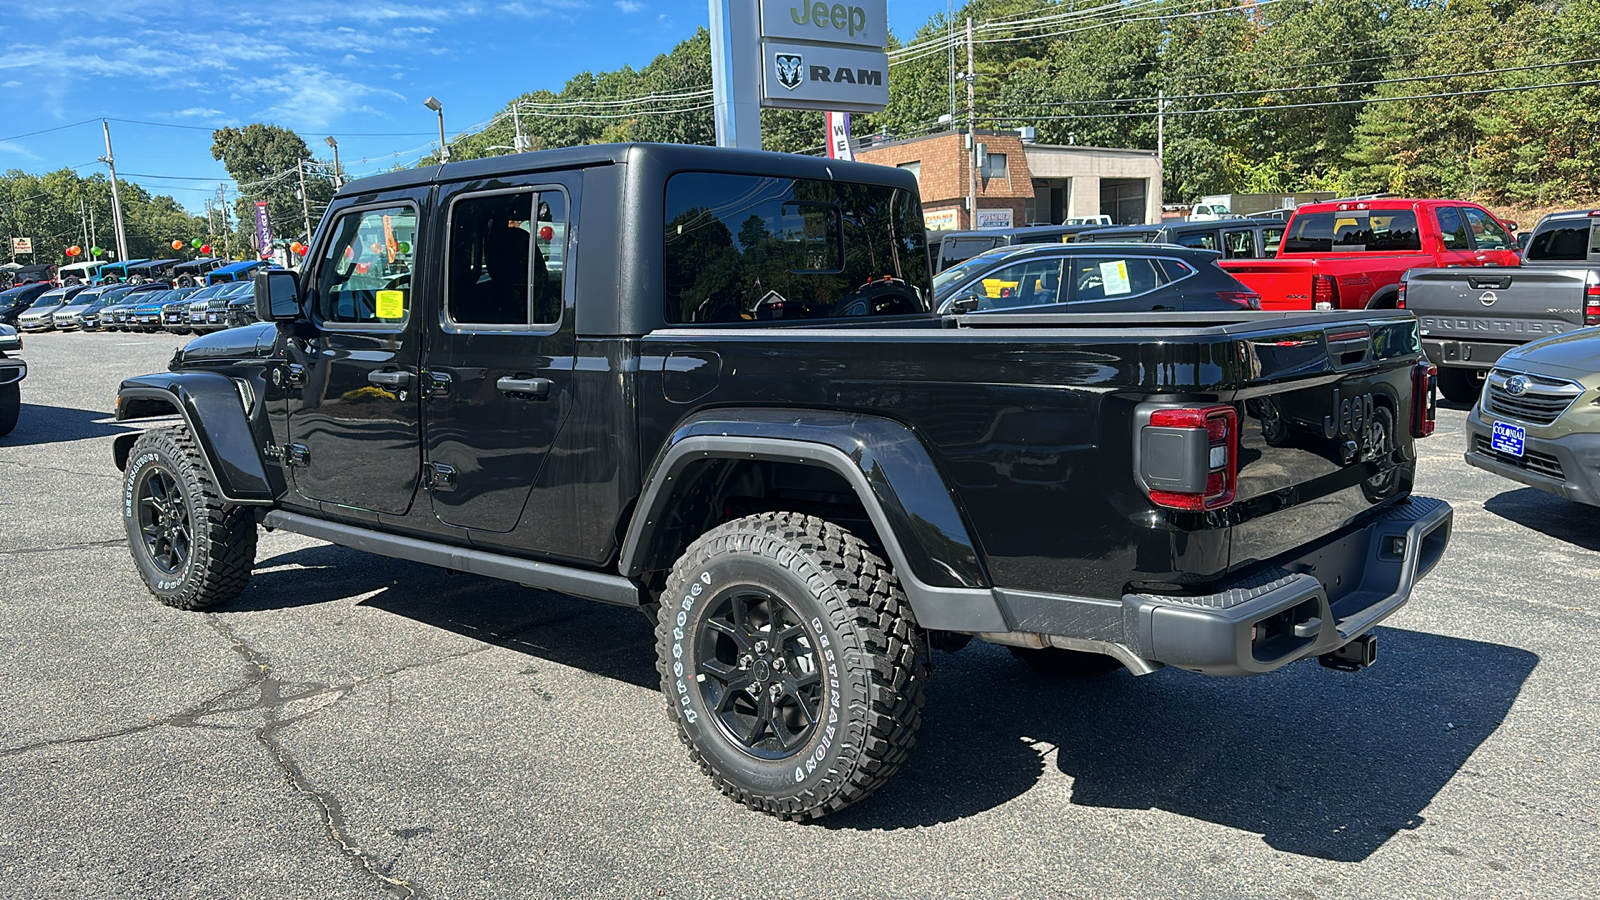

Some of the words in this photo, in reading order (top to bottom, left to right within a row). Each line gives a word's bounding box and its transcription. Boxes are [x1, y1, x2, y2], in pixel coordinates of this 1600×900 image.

[790, 0, 866, 37] Jeep
[809, 65, 882, 86] RAM
[1421, 317, 1564, 334] FRONTIER
[1324, 388, 1374, 439] Jeep
[263, 440, 286, 461] Jeep
[806, 617, 839, 775] DESTINATION
